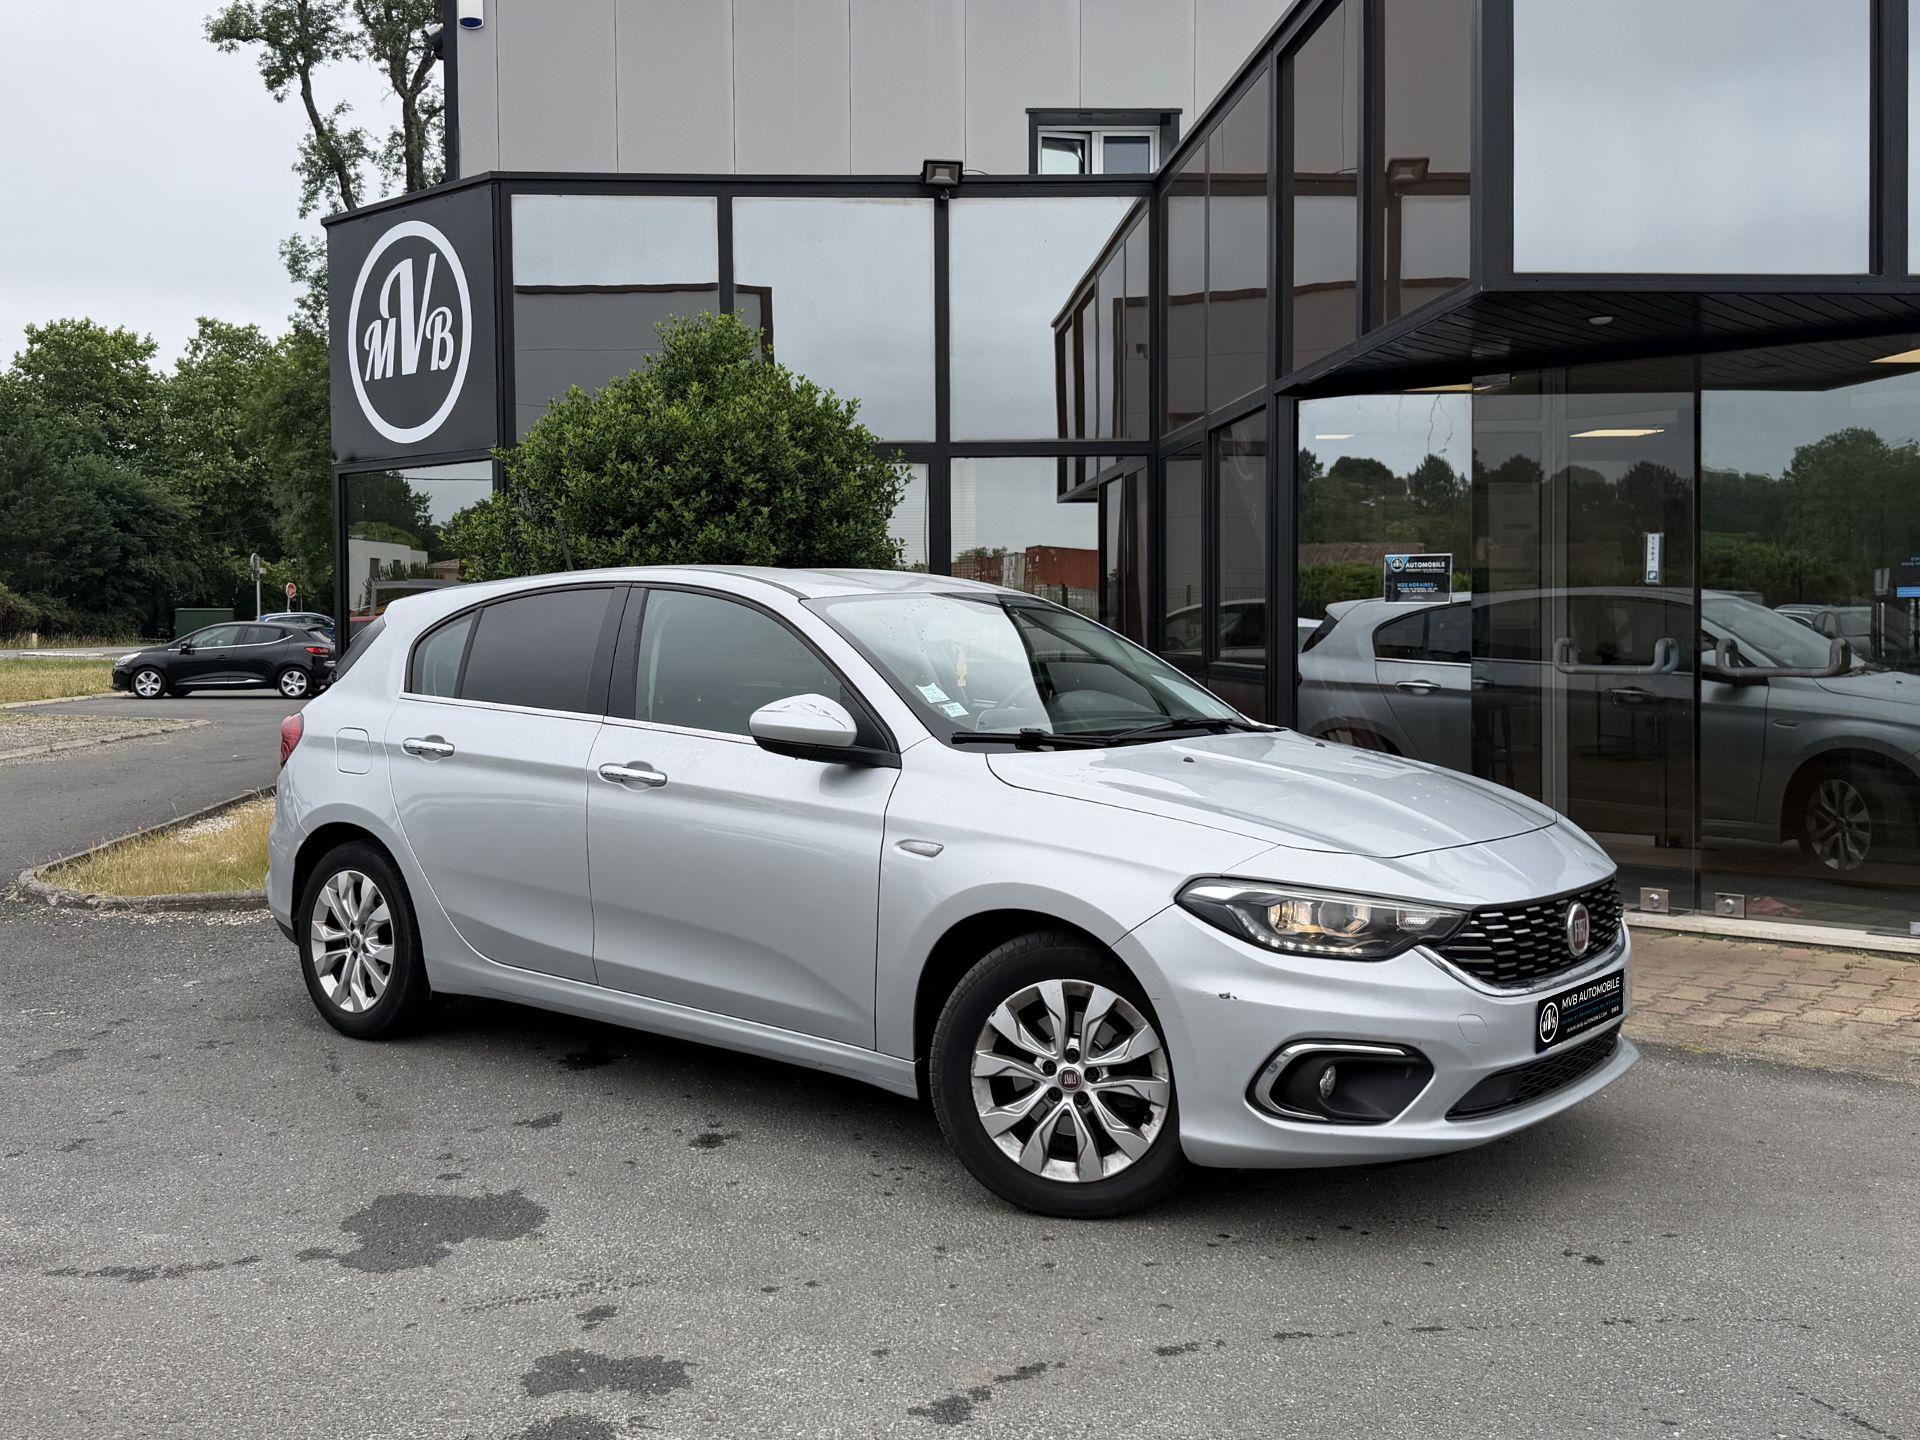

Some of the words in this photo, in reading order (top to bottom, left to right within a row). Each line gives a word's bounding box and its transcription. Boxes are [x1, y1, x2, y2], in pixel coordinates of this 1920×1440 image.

[364, 253, 454, 381] MVB
[1561, 994, 1578, 1010] MVB
[1578, 976, 1620, 1003] AUTOMOBILE
